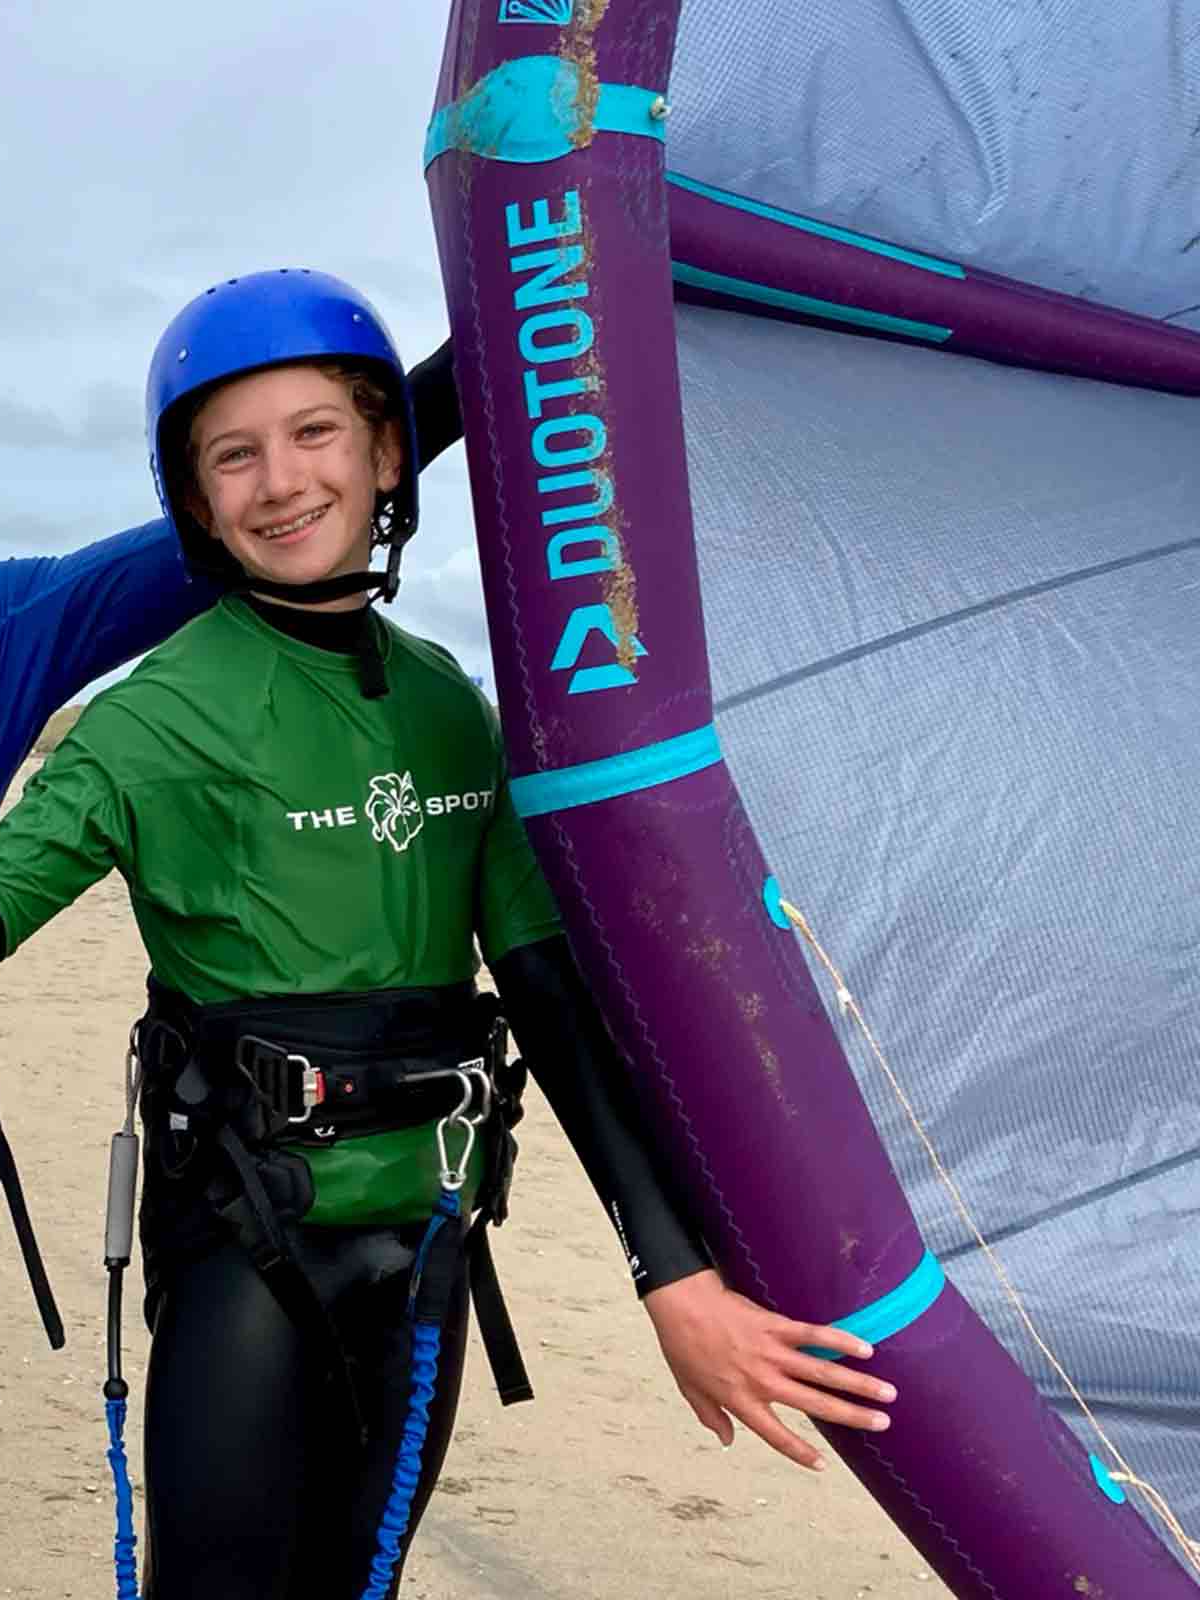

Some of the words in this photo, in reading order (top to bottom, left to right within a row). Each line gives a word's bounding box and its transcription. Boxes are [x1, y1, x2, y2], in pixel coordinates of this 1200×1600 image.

[504, 189, 623, 582] DUOTONE
[286, 806, 357, 831] THE
[426, 790, 494, 816] SPOT
